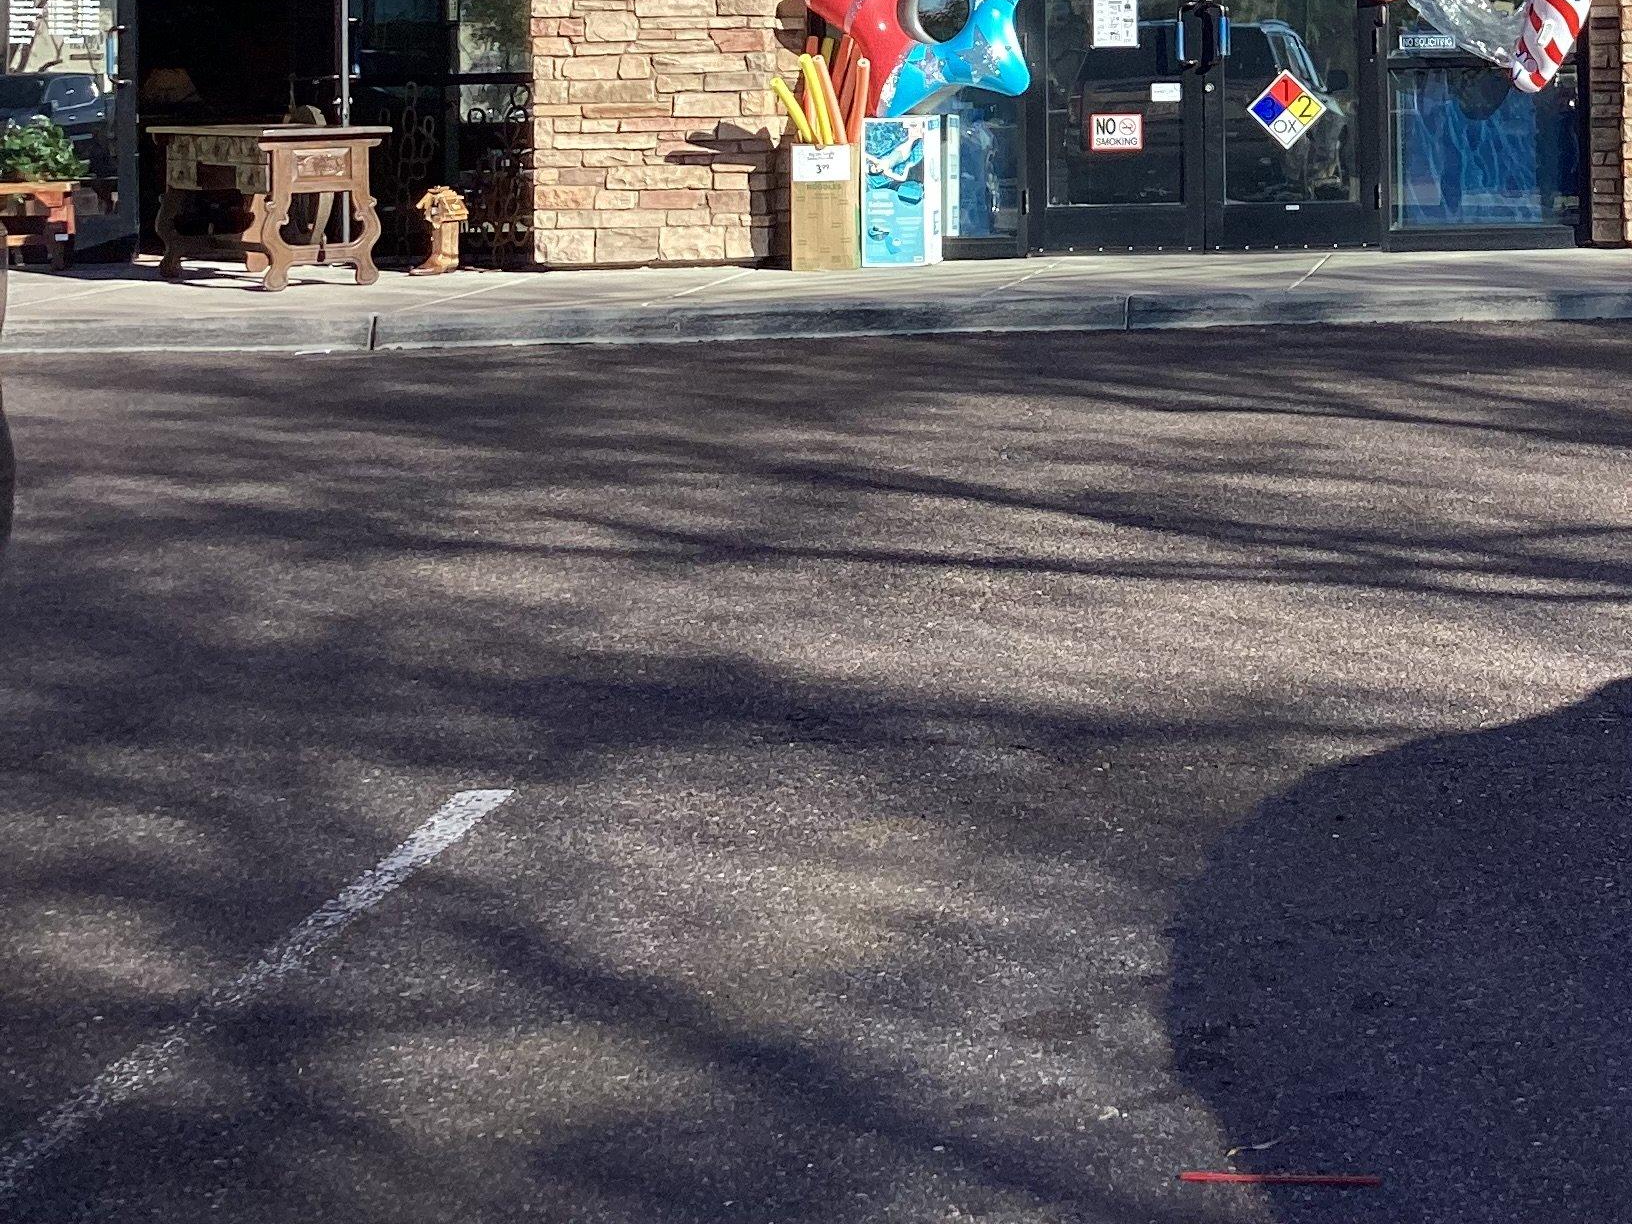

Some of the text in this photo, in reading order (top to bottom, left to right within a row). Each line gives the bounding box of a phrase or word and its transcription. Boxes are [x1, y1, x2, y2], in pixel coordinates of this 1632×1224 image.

[1282, 79, 1289, 102] 1
[1262, 96, 1275, 120] 3
[1297, 95, 1312, 118] 2
[1096, 117, 1116, 135] NO
[1273, 119, 1297, 134] OX
[1095, 137, 1138, 146] SMOKING
